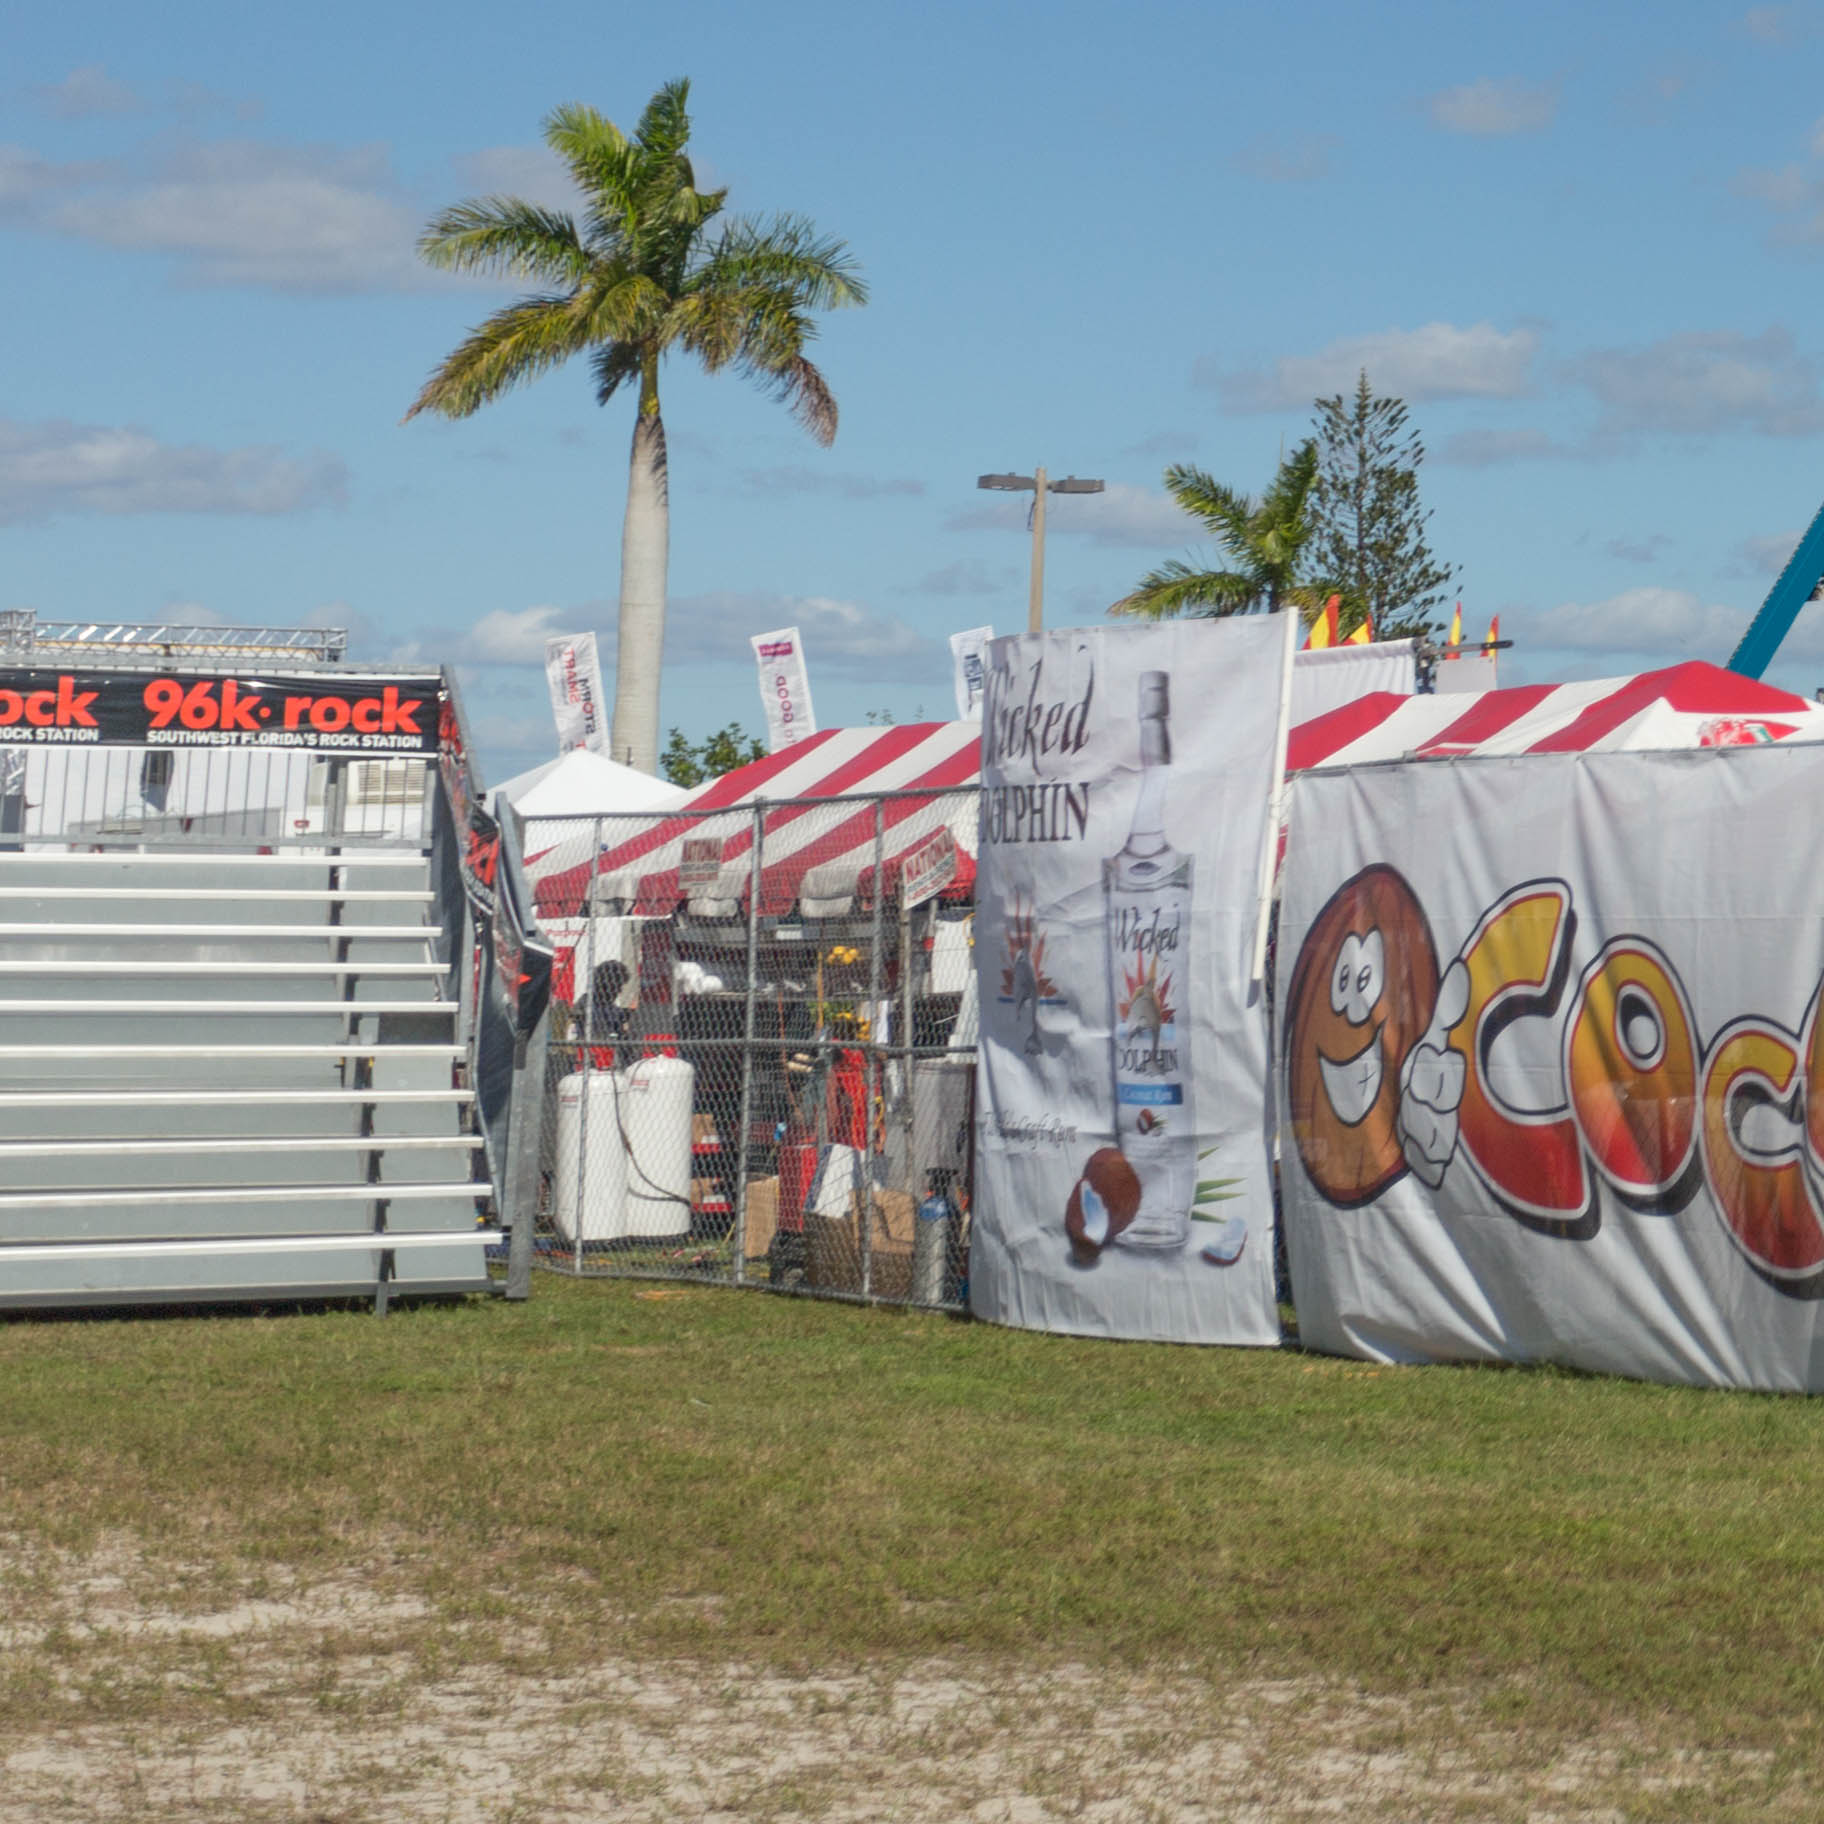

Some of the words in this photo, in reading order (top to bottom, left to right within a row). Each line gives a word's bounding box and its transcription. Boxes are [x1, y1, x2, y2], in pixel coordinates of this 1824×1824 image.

[284, 686, 423, 734] rock
[35, 728, 98, 742] STATION
[147, 730, 239, 745] SOUTHWEST
[241, 733, 317, 747] FLORIDA'S
[319, 734, 361, 747] ROCK
[361, 735, 422, 749] STATION
[1115, 903, 1182, 953] Wicked
